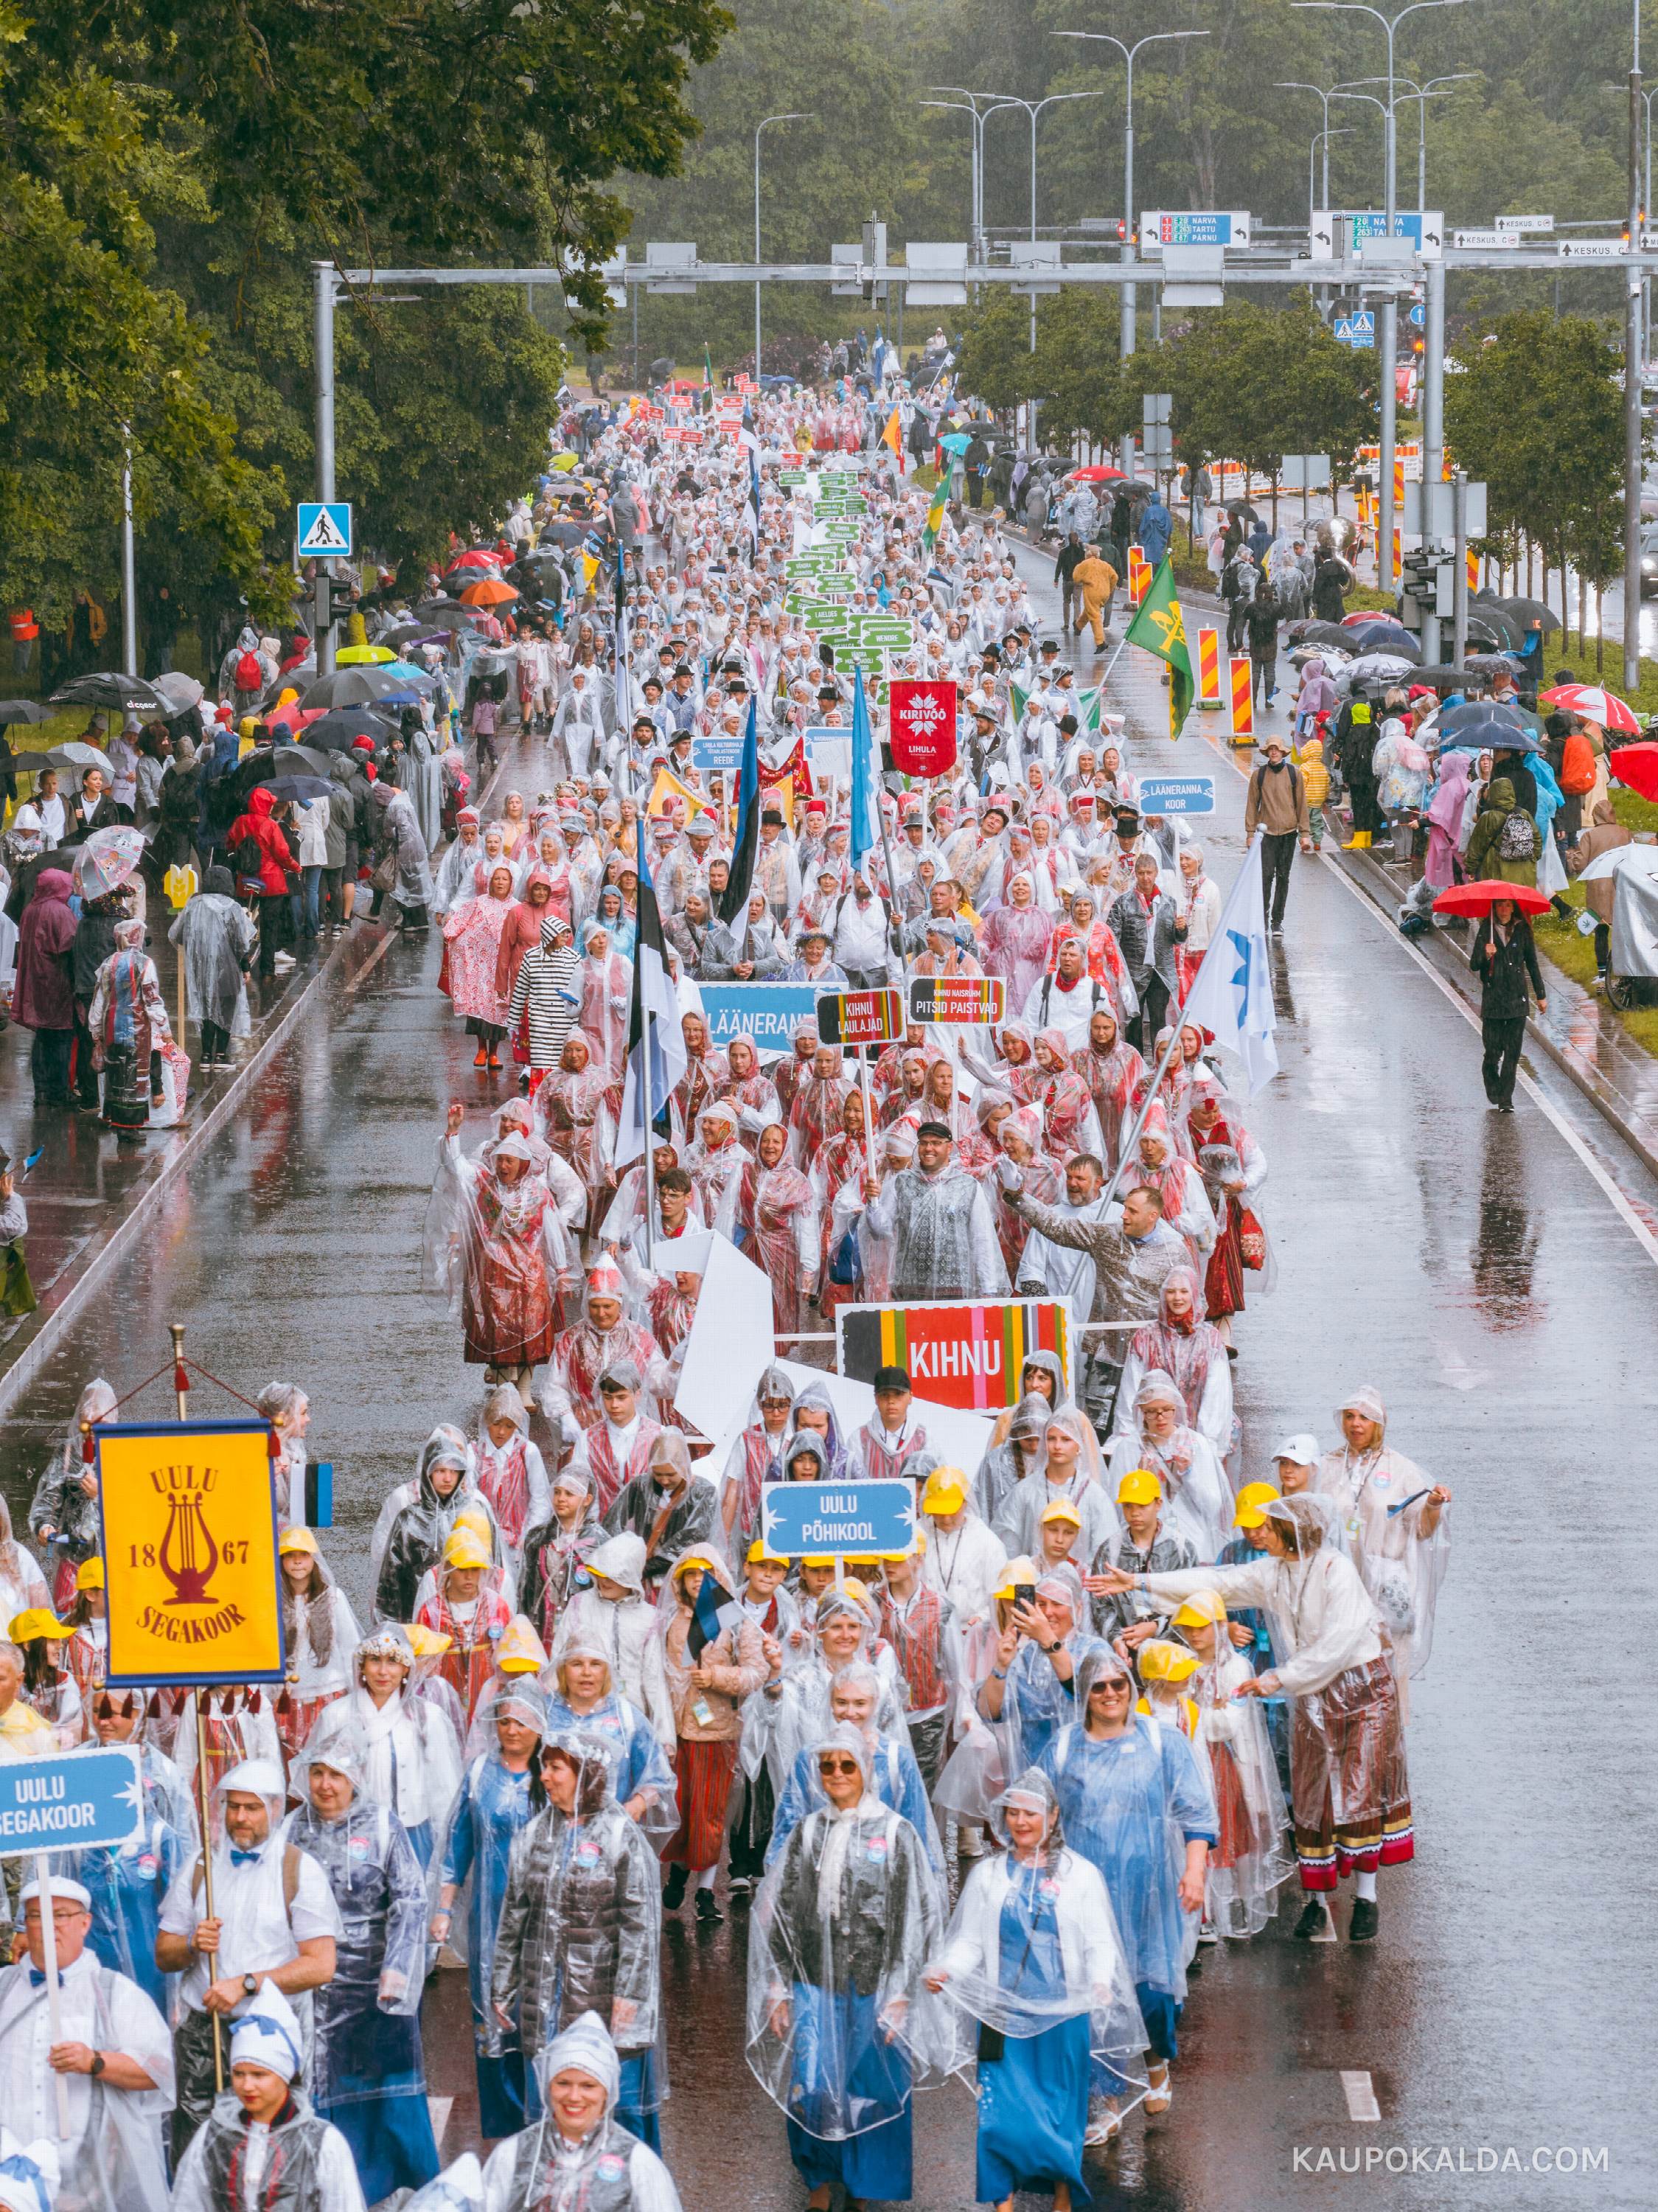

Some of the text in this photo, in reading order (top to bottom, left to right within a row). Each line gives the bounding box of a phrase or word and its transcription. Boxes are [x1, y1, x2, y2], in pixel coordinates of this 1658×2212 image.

[714, 756, 735, 765] REEDE
[1150, 784, 1202, 796] LÄÄNERANNA
[1165, 799, 1186, 809] KOOR
[933, 989, 981, 998] KIHNU NAISRÜHM
[846, 1001, 873, 1017] KIHNU
[916, 1001, 998, 1015] PITSID PAISTVAD
[707, 1009, 806, 1034] LÄÄNERAN
[837, 1018, 883, 1035] LAULAJAD
[910, 1339, 1000, 1378] KIHNU
[149, 1465, 219, 1494] UULU
[820, 1495, 857, 1514] UULU
[802, 1519, 877, 1543] PÕHIKOOL
[128, 1540, 249, 1568] 18 67
[135, 1603, 248, 1644] SEGAKOOR
[15, 1775, 66, 1804] UULU
[0, 1802, 97, 1835] EGAKOOR
